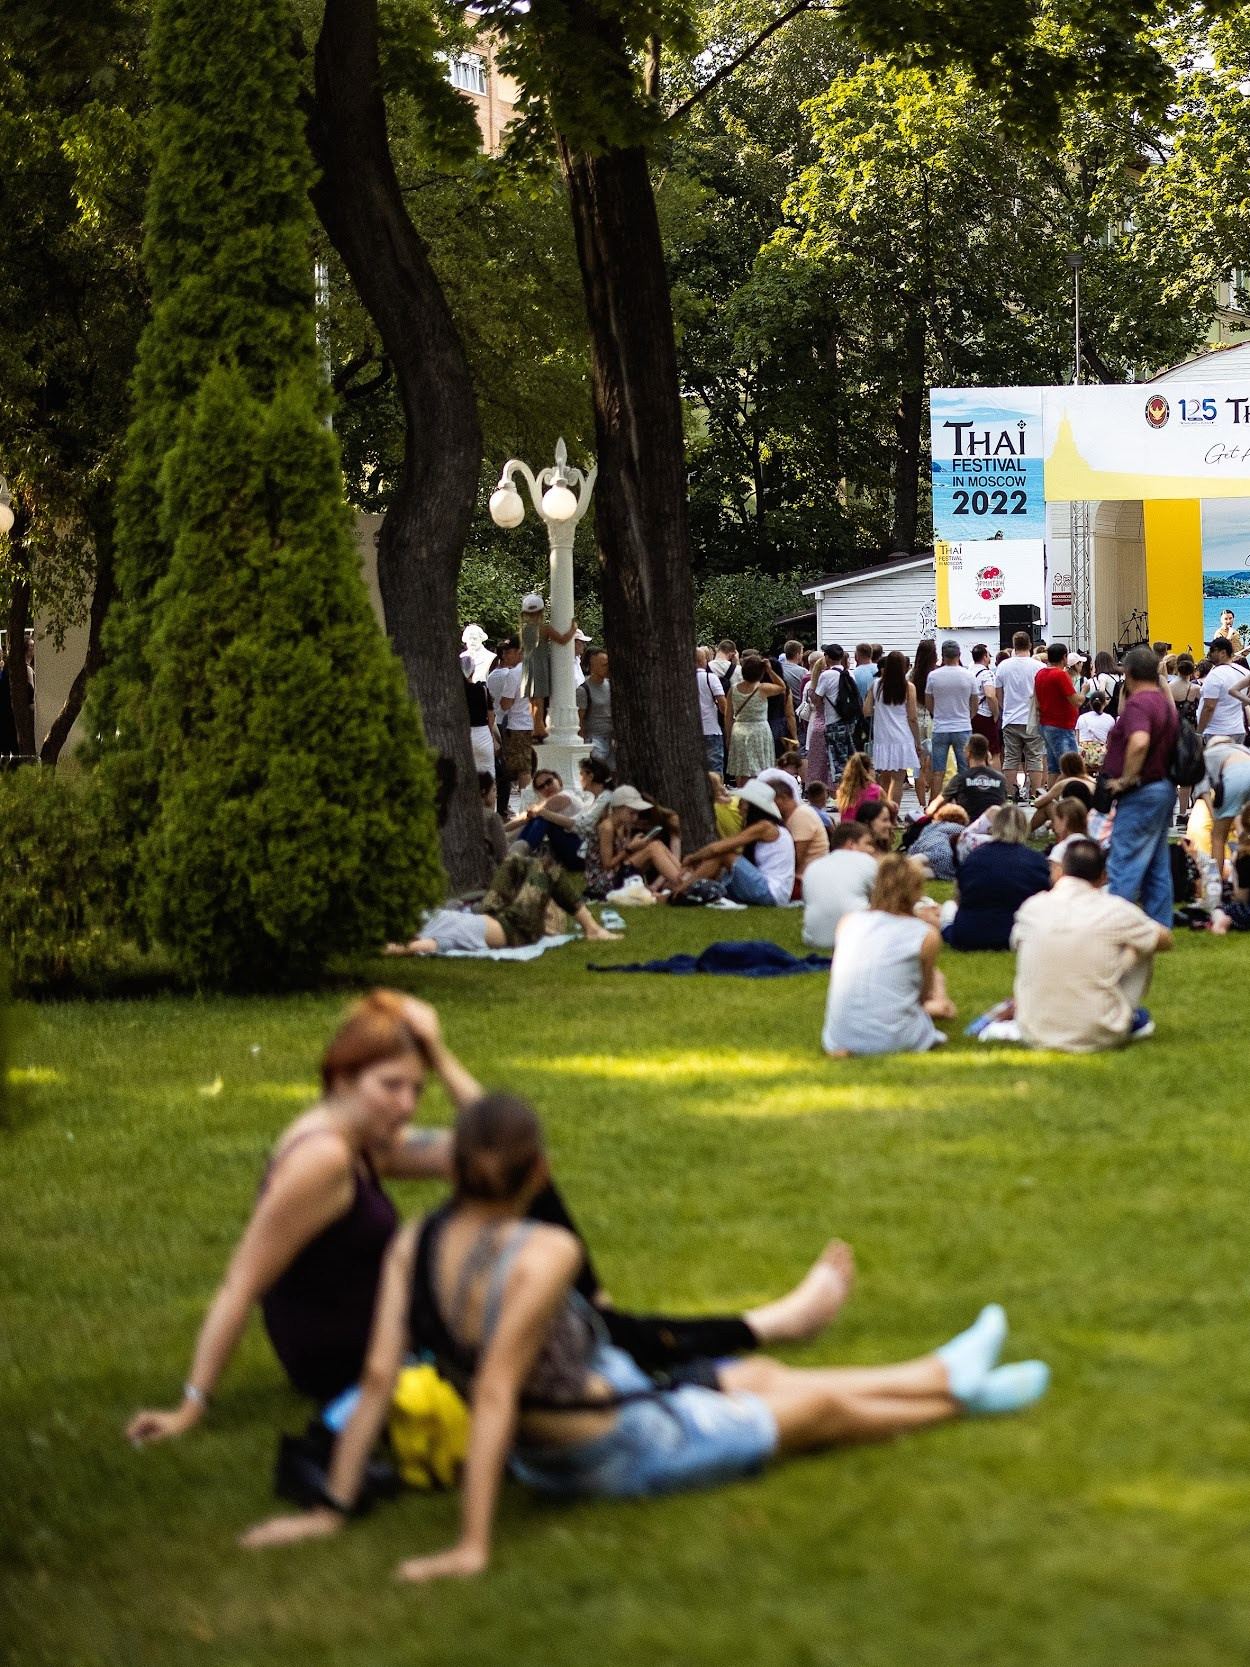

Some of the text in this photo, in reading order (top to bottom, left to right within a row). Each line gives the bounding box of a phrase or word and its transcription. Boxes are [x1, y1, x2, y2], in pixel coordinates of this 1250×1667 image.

[1178, 398, 1217, 421] 125
[1204, 443, 1240, 464] Get
[952, 458, 1026, 472] FESTIVAL
[952, 476, 1026, 487] IN MOSCOW
[952, 490, 1027, 515] 2022
